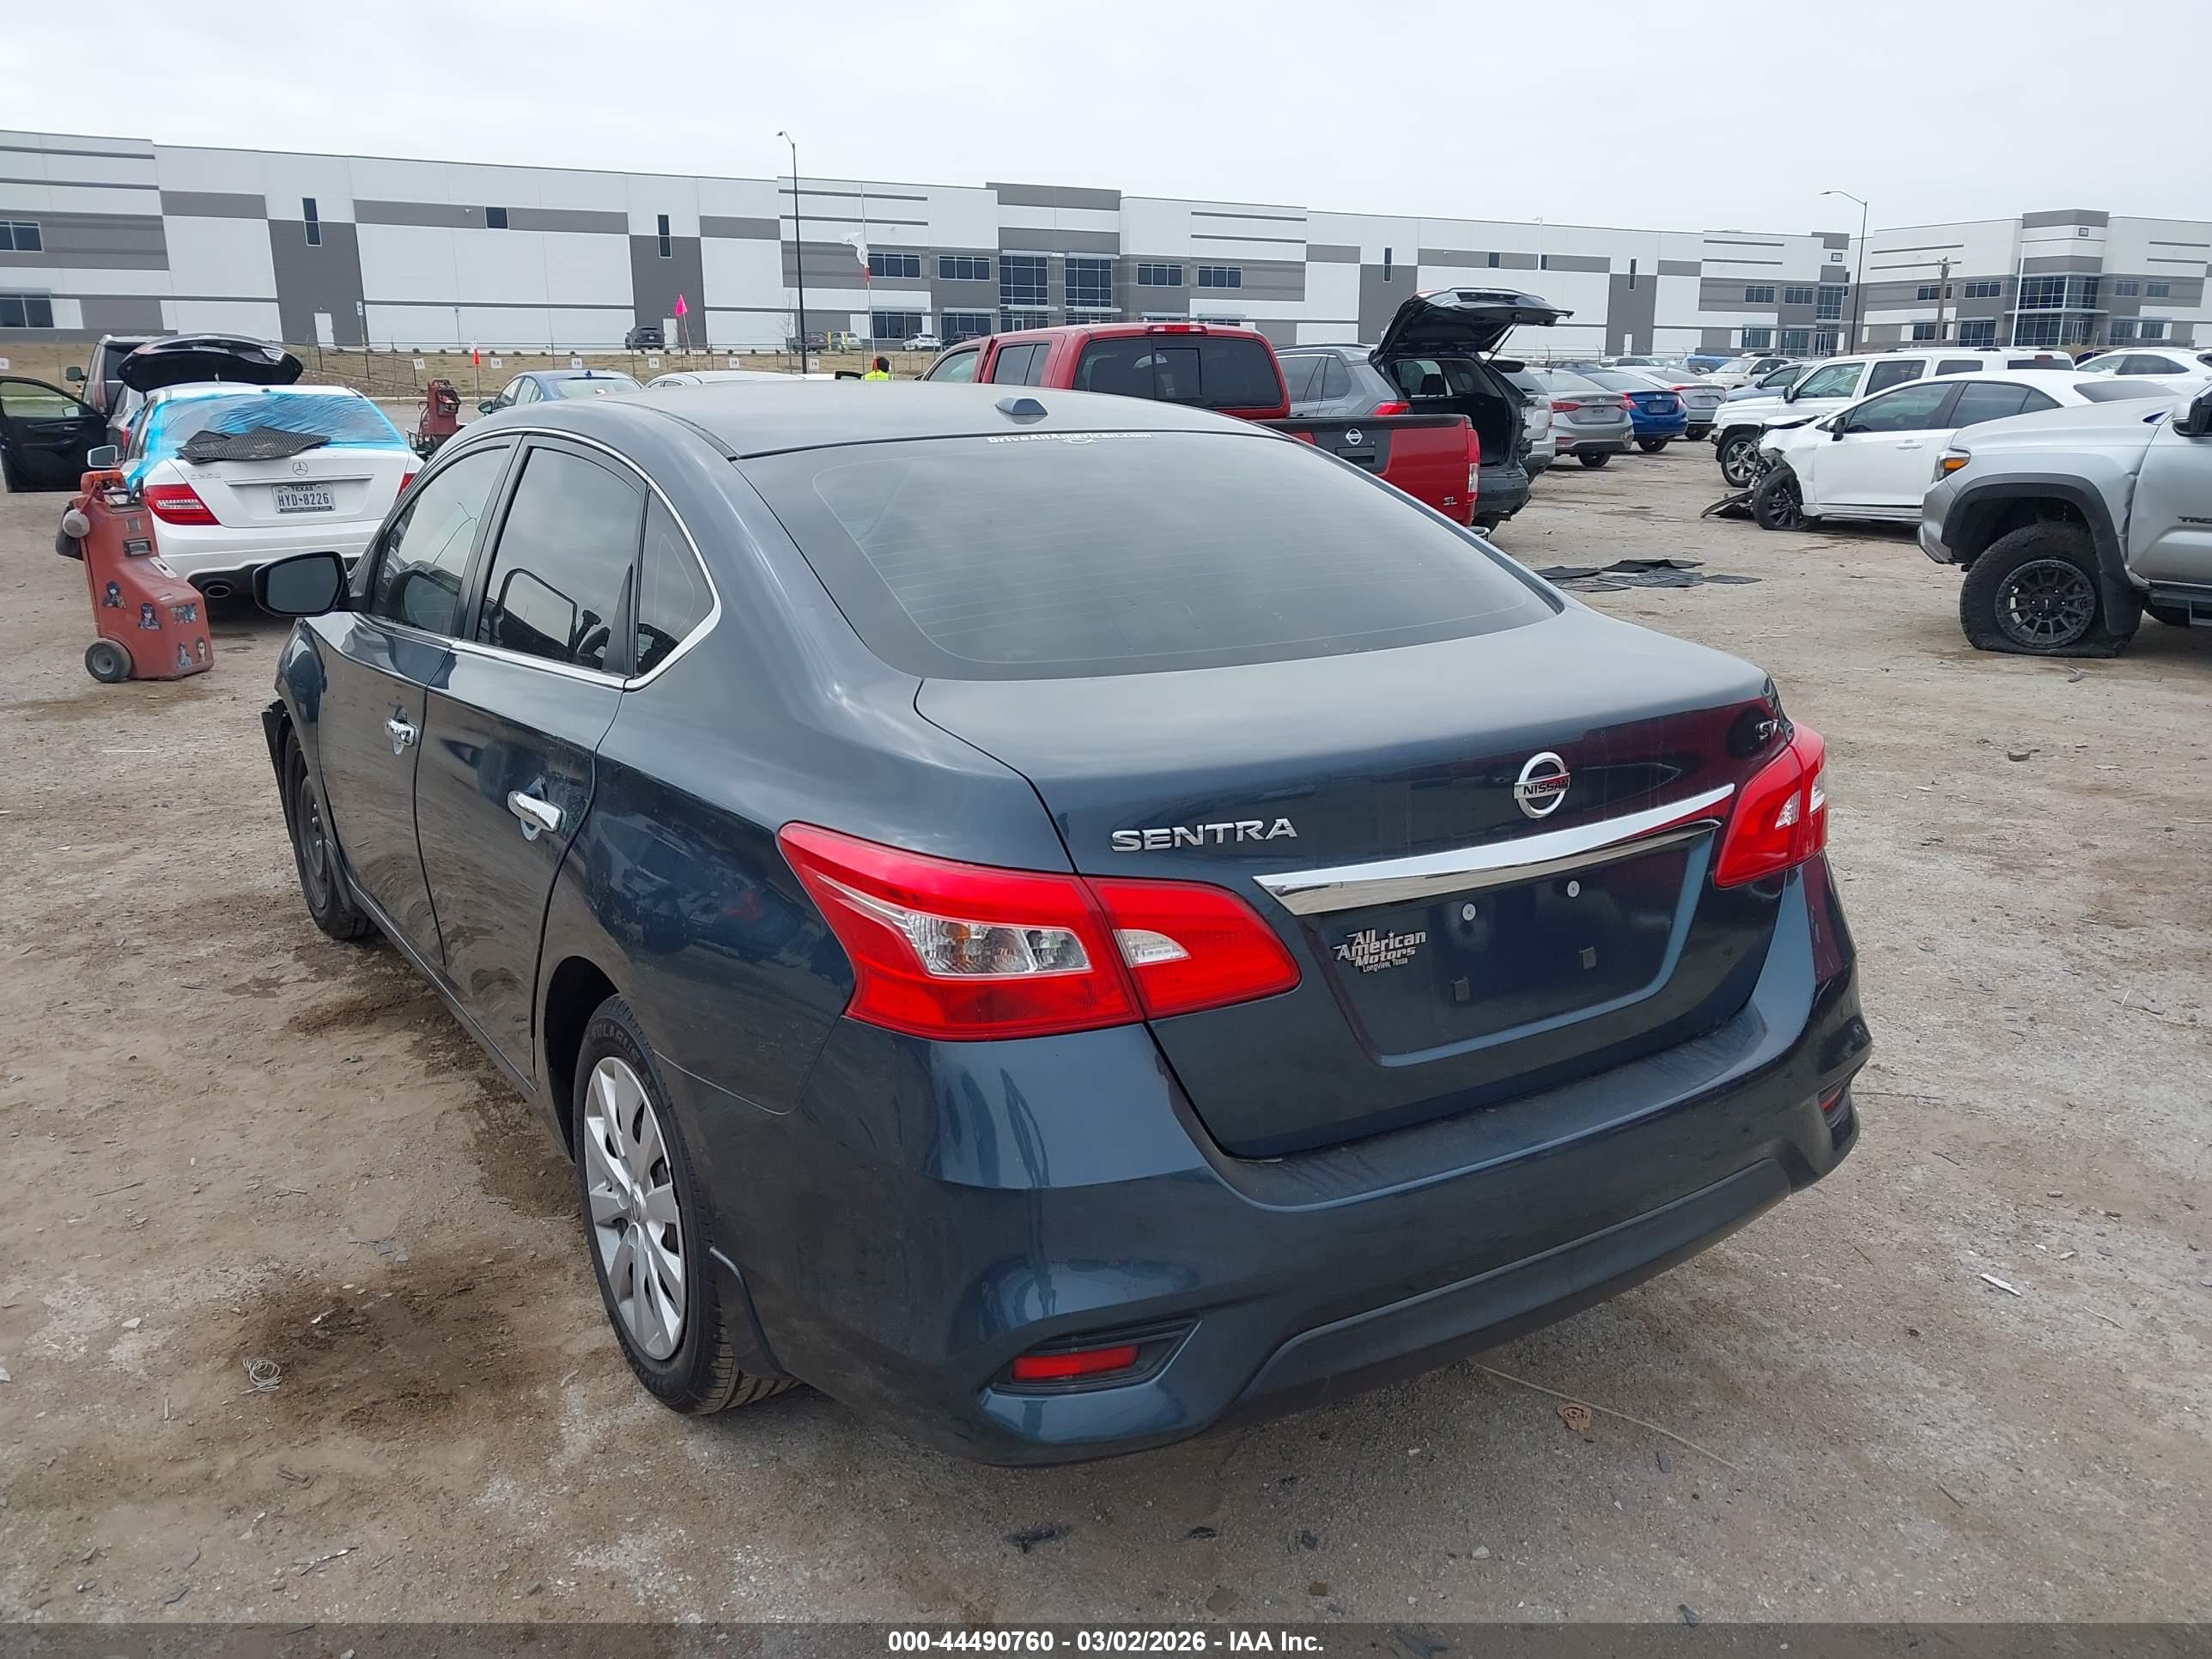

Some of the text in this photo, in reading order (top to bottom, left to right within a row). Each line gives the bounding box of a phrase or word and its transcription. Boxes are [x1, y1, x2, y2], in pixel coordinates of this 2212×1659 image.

[1756, 719, 1779, 740] SV
[1523, 779, 1568, 796] NISSAN
[1111, 817, 1298, 852] SENTRA
[1333, 931, 1426, 960] American
[1346, 929, 1376, 946] All
[1347, 946, 1416, 967] Motors
[1363, 957, 1408, 973] Longview, Texas
